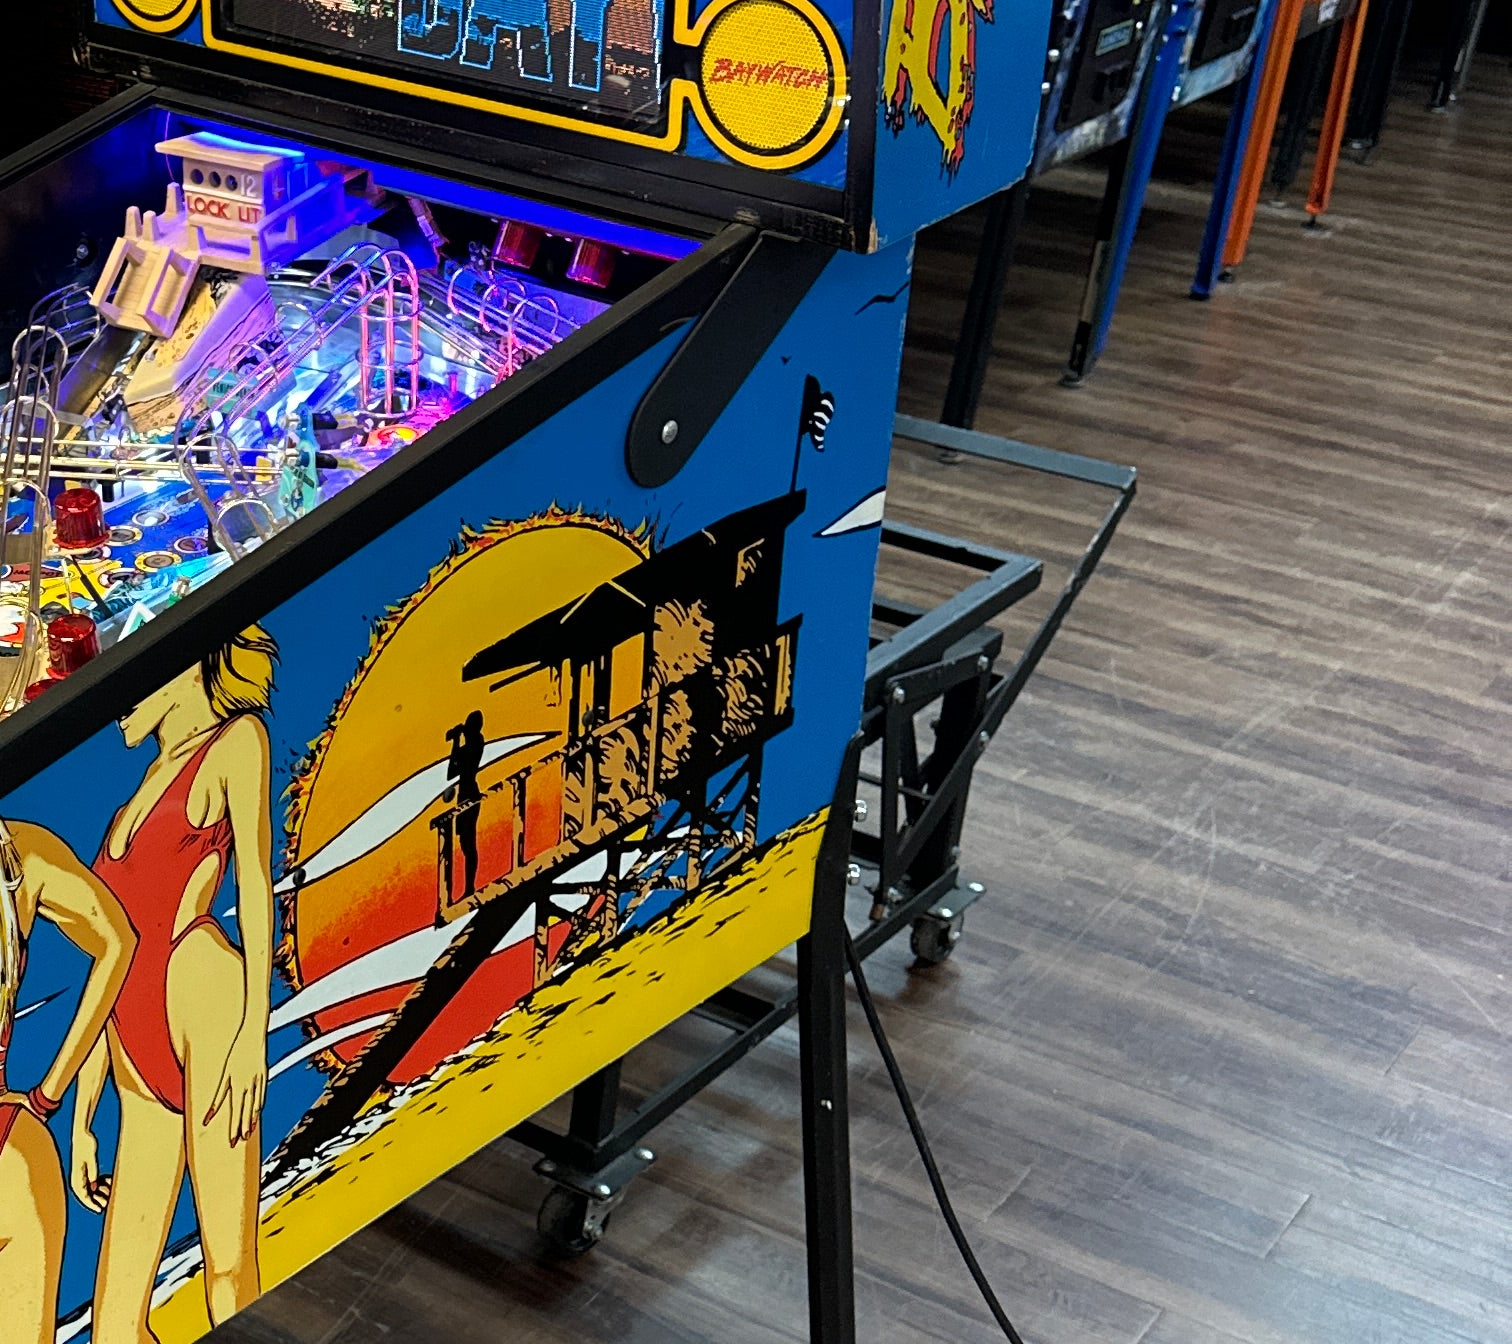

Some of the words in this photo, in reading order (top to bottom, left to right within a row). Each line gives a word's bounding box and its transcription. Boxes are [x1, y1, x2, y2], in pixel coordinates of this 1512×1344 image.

[710, 56, 829, 90] BAYWATCH
[239, 172, 259, 196] 12
[187, 195, 230, 221] LOCK
[239, 205, 261, 224] LIT
